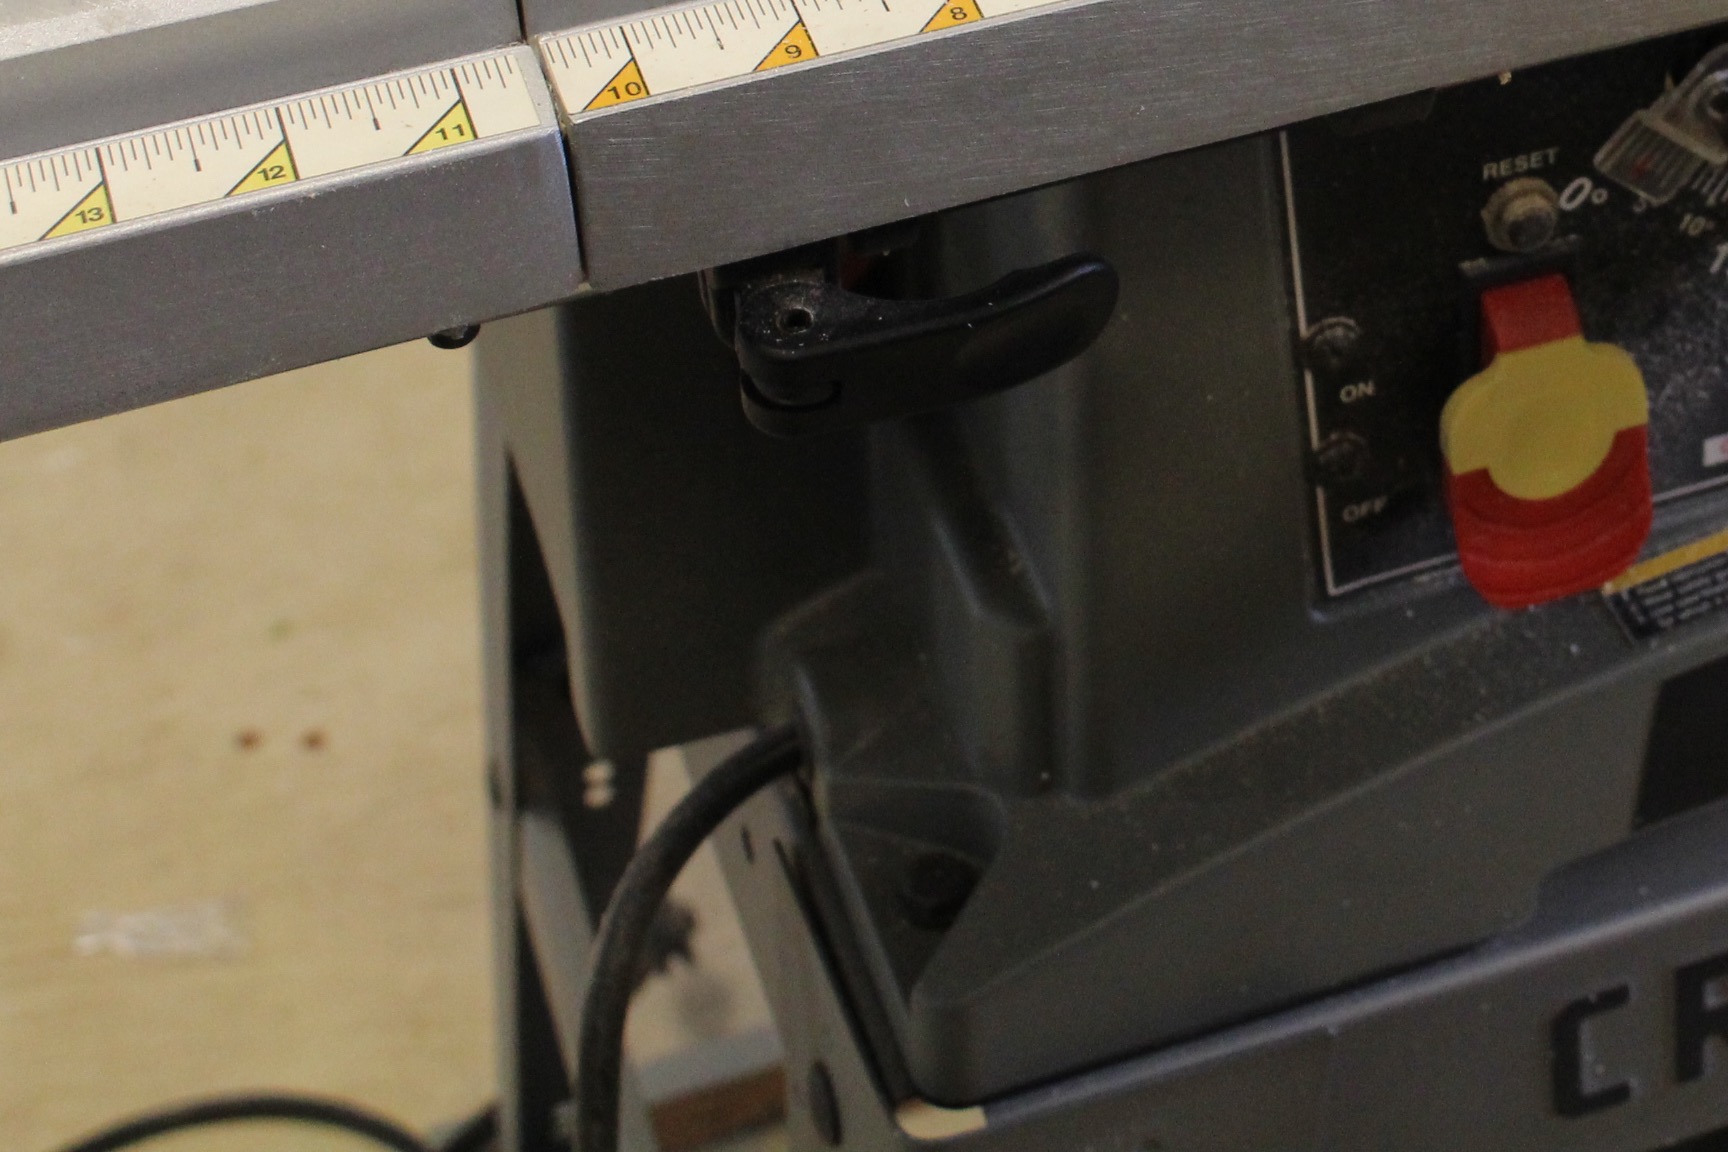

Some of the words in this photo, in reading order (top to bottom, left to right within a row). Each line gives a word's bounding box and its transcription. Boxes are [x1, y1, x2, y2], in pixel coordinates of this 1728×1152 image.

[950, 6, 968, 22] 8
[785, 44, 802, 61] 9
[608, 81, 642, 100] 10
[436, 123, 466, 142] 11
[257, 164, 286, 182] 12
[1482, 147, 1559, 181] RESET
[75, 207, 104, 225] 13
[1339, 380, 1376, 404] ON
[1342, 495, 1388, 523] OFF
